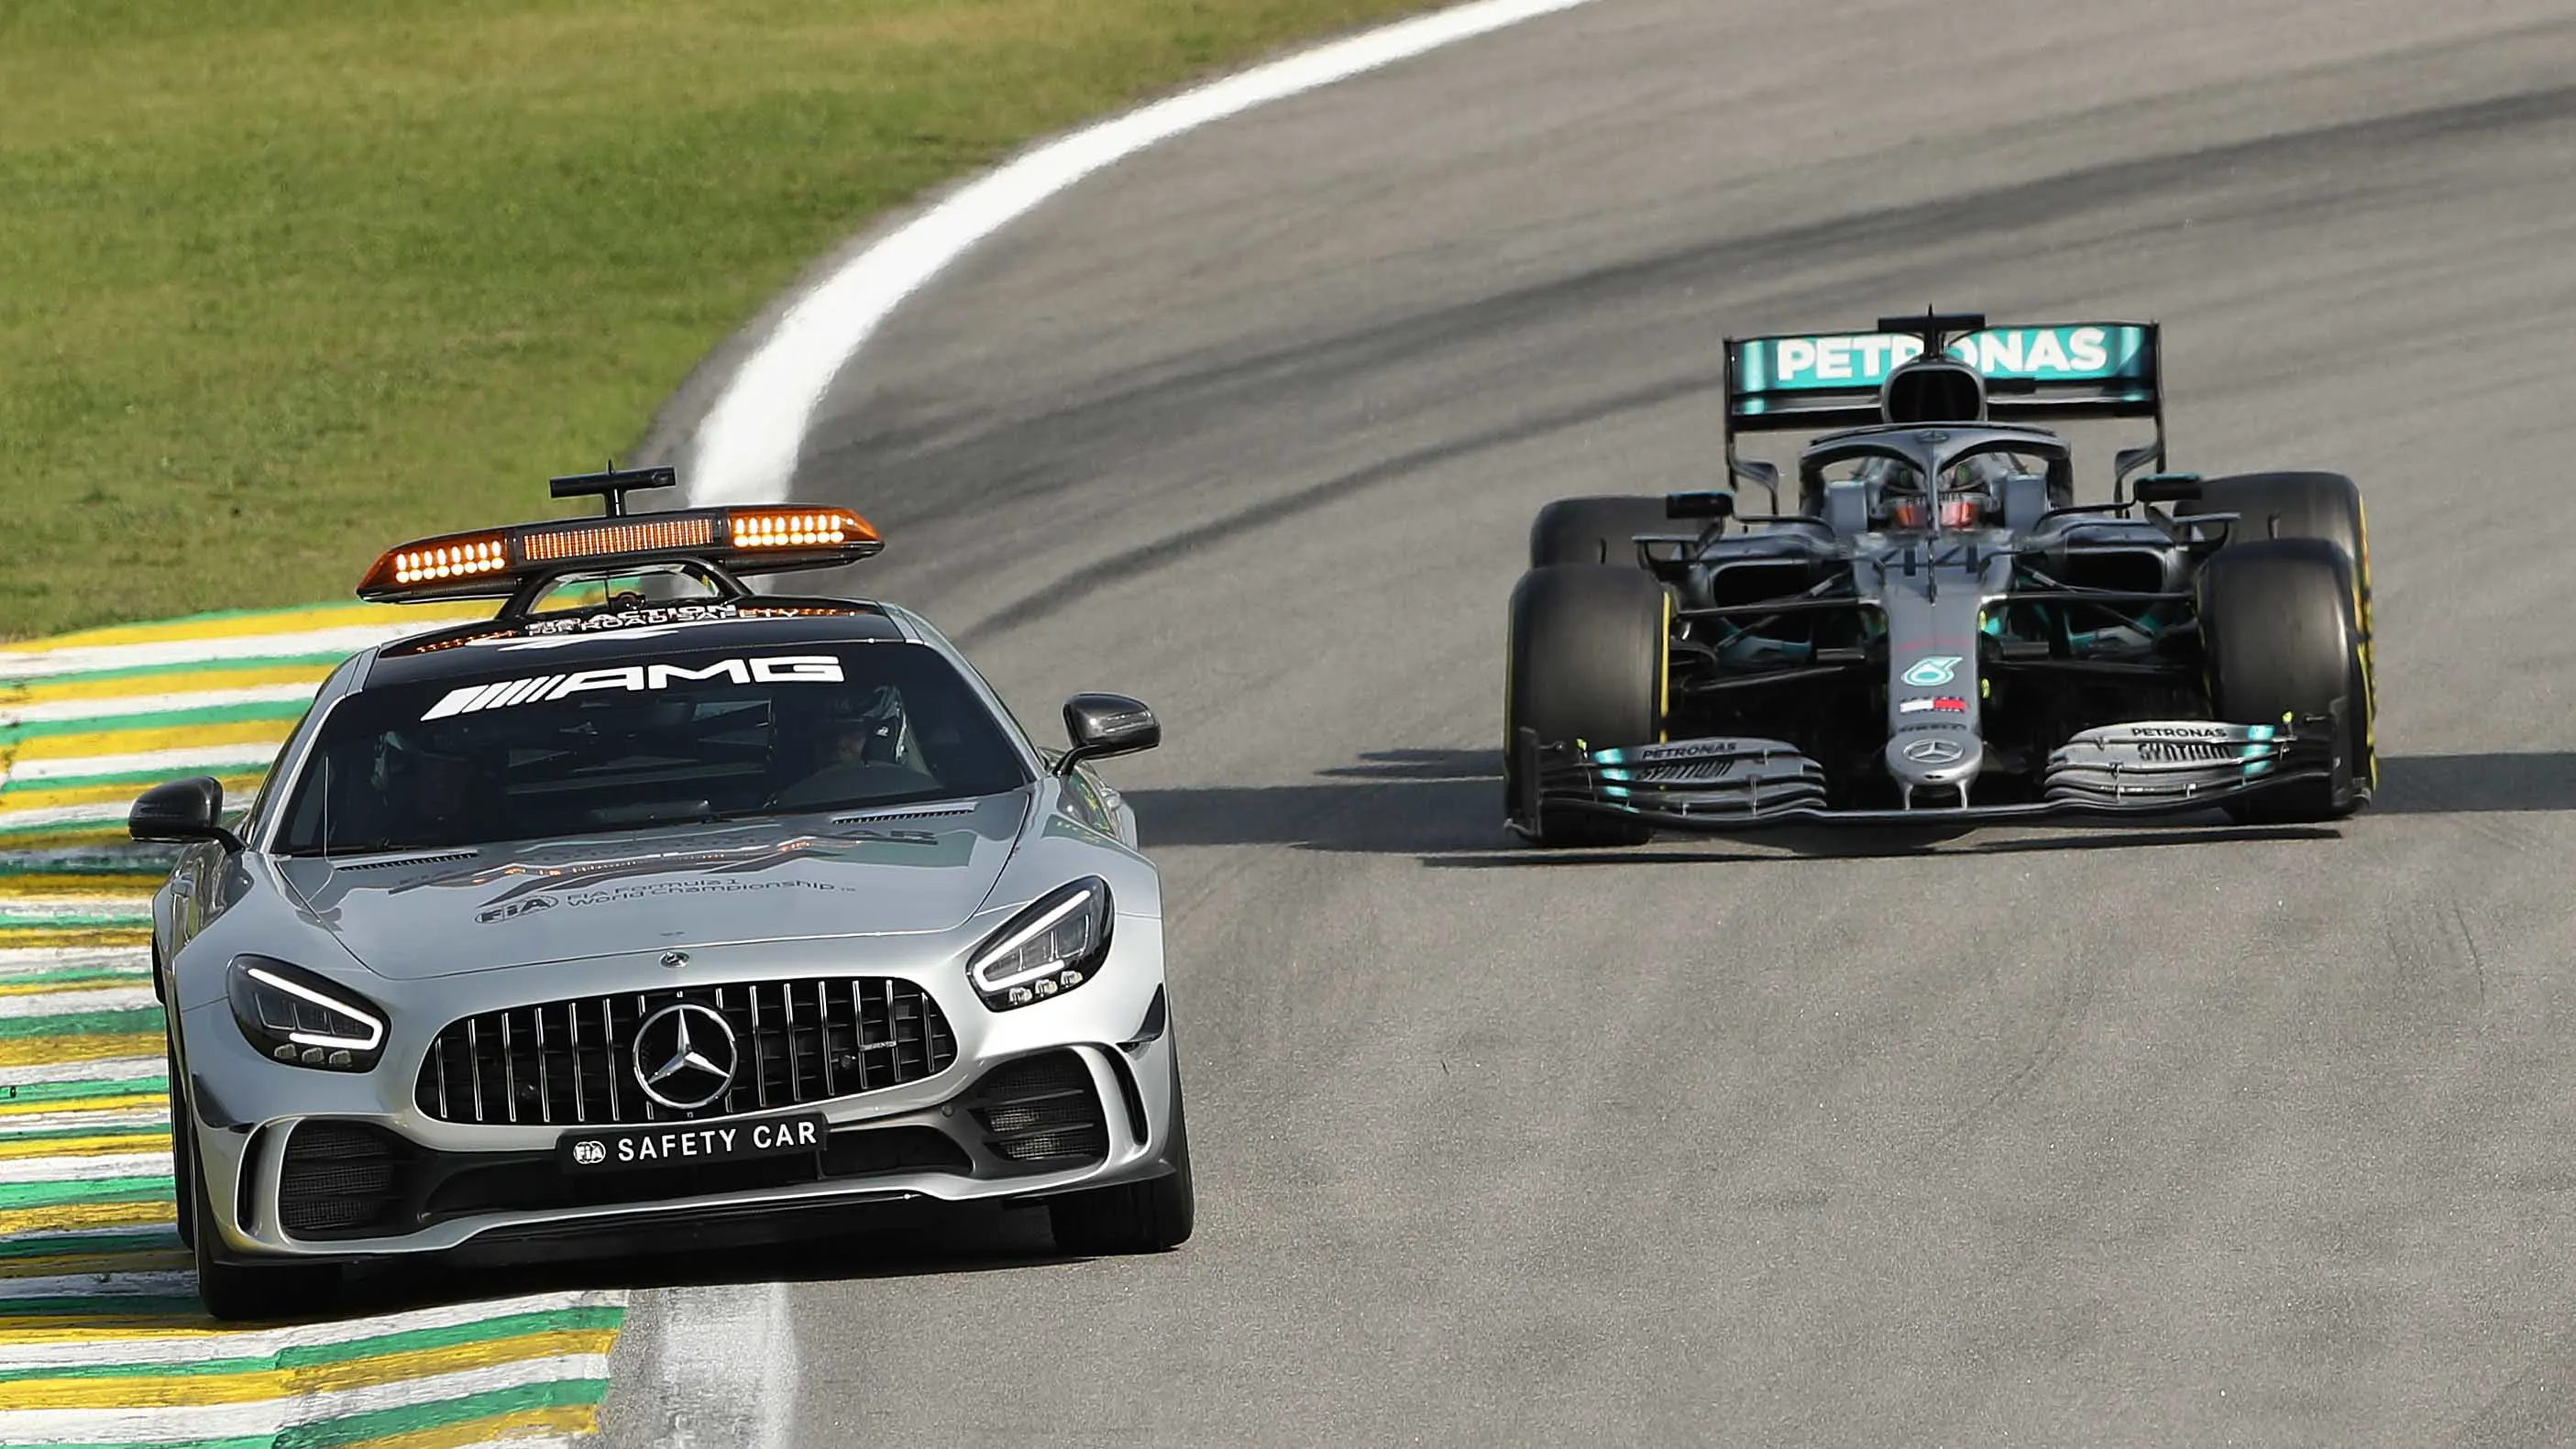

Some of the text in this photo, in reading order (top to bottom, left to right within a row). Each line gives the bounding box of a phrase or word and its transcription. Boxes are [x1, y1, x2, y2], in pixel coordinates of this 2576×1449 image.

[579, 615, 668, 631] ROAD
[677, 608, 800, 622] SAFETY
[546, 655, 844, 701] AMG
[2130, 727, 2228, 739] PETRONAS
[1641, 741, 1738, 760] PETRONAS
[567, 877, 741, 901] FIA Formula 1
[567, 891, 645, 907] World
[479, 897, 555, 924] FIA
[574, 1121, 817, 1162] FIA SAFETY CAR
